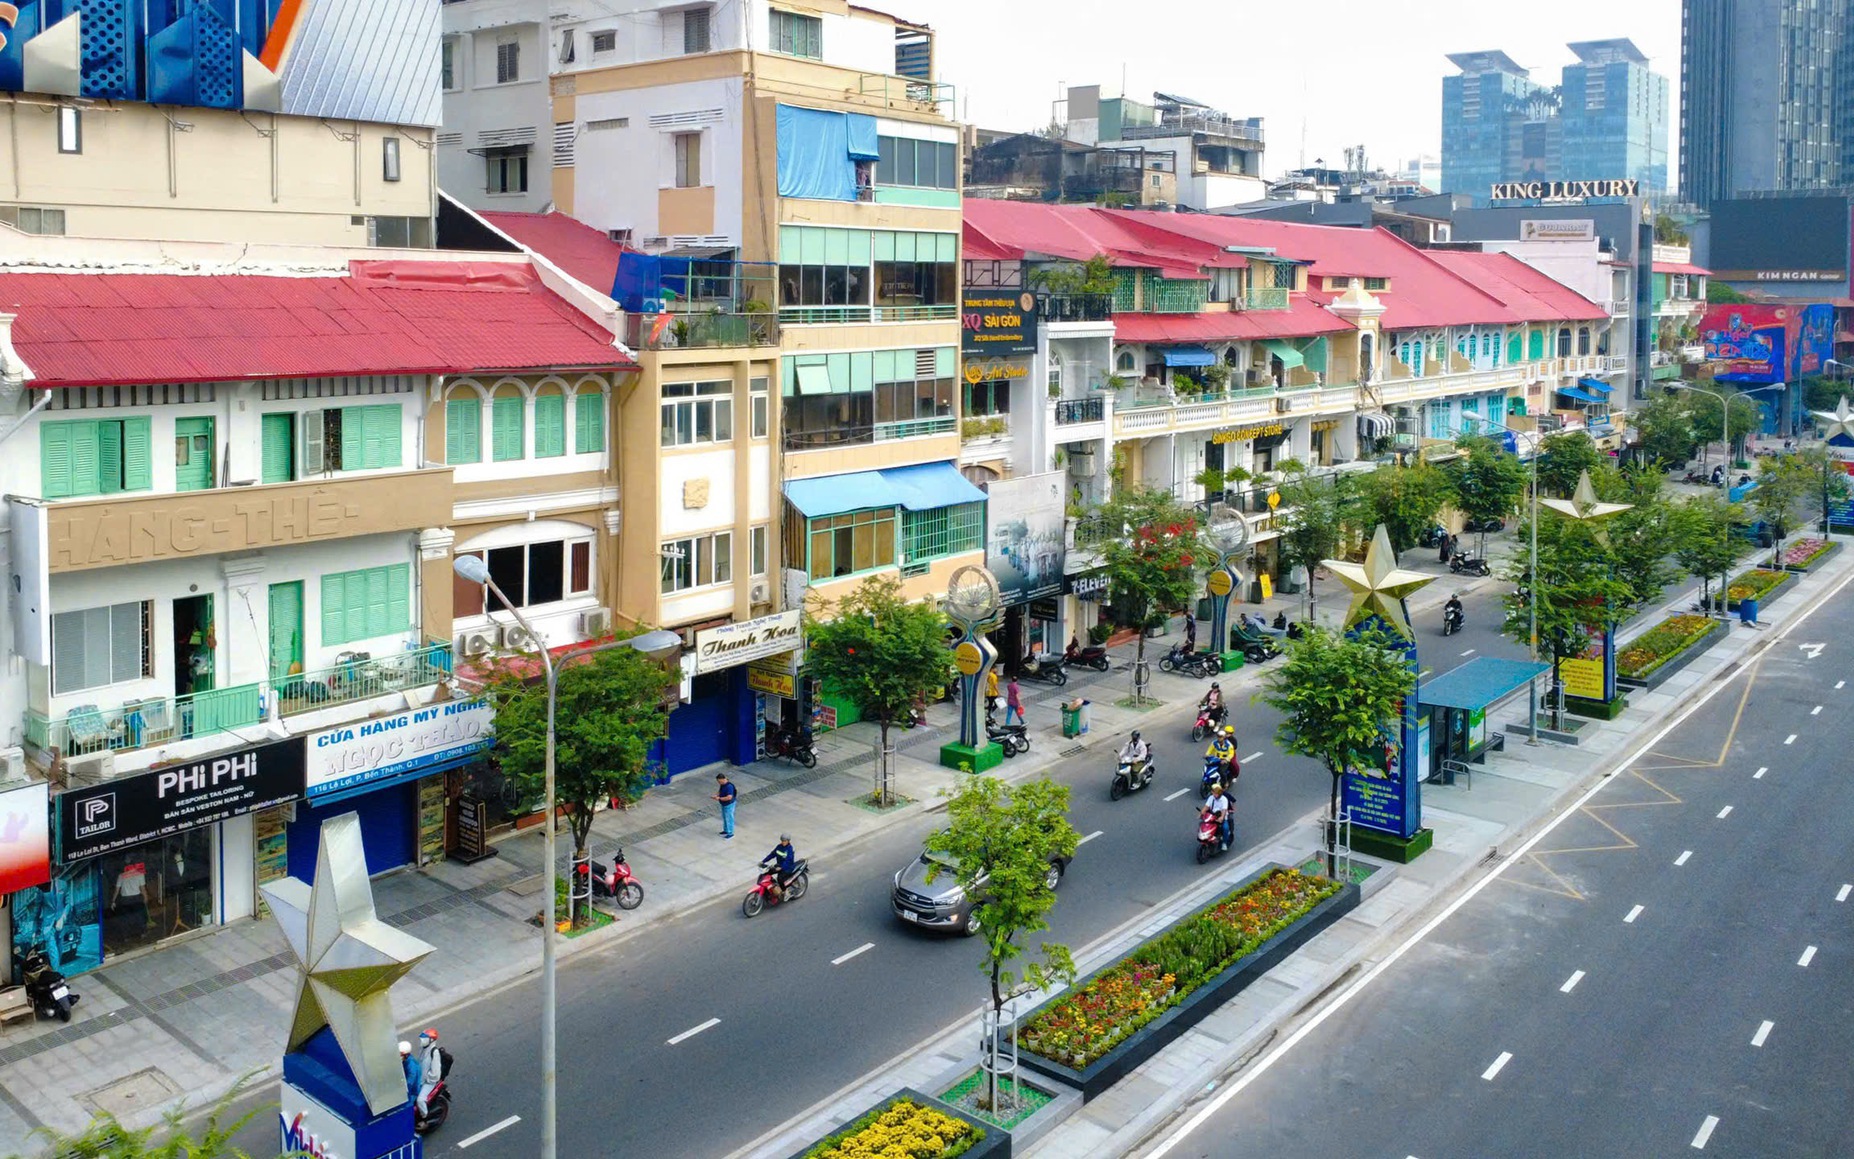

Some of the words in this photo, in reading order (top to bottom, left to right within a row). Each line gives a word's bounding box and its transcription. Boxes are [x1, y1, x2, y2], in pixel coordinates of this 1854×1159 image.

[1491, 182, 1542, 200] KING
[1550, 179, 1638, 198] LUXURY
[1757, 272, 1780, 280] KIM
[1782, 272, 1817, 280] NGAN
[962, 313, 982, 332] XQ
[702, 632, 757, 657] Thanh
[762, 625, 797, 641] Hoa
[360, 715, 408, 738] HÀNG
[175, 793, 208, 807] BESPOKE
[209, 785, 244, 799] TAILORING
[196, 799, 223, 811] VESTON
[80, 820, 111, 835] TAILOR
